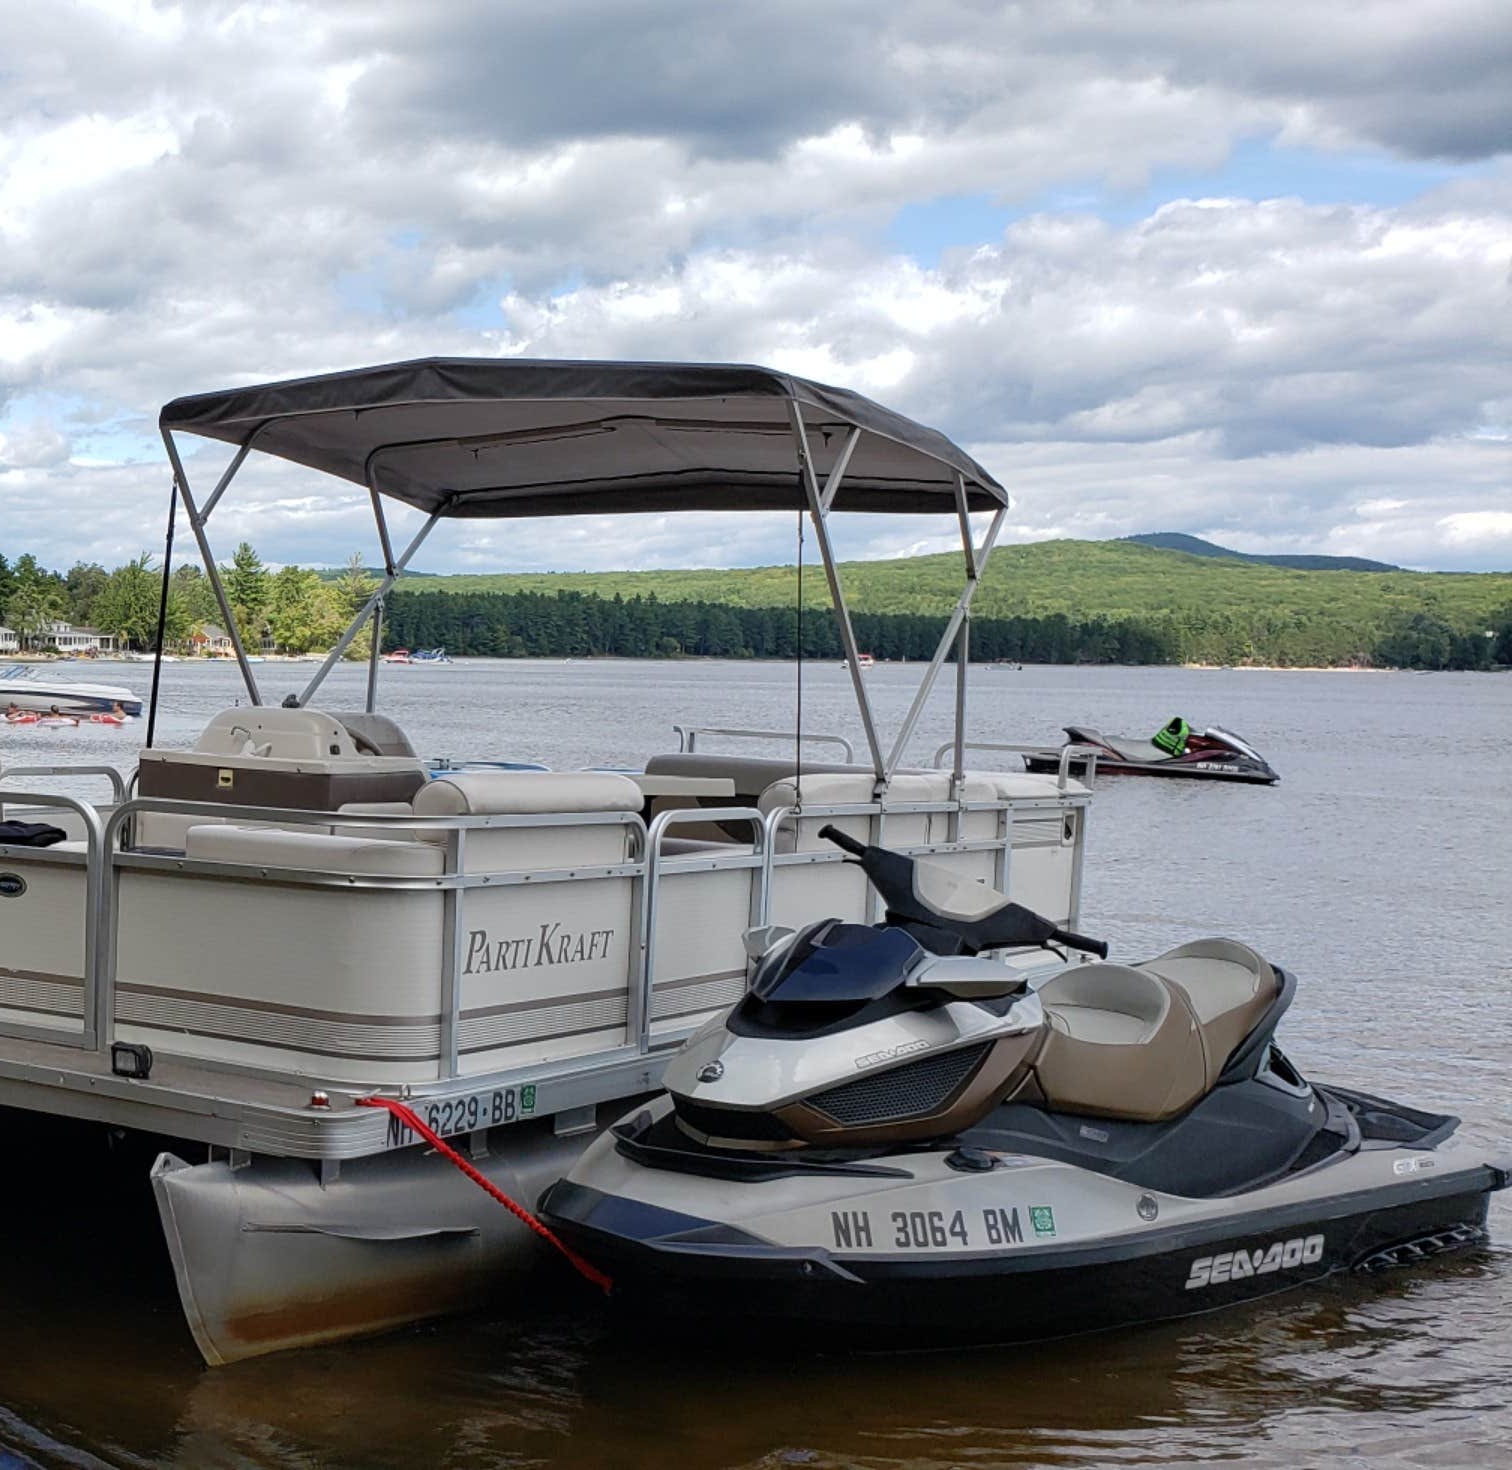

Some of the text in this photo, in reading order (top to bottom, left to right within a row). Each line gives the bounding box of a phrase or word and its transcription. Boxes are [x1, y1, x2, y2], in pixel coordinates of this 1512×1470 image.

[831, 1206, 1025, 1248] NH 3064 BM
